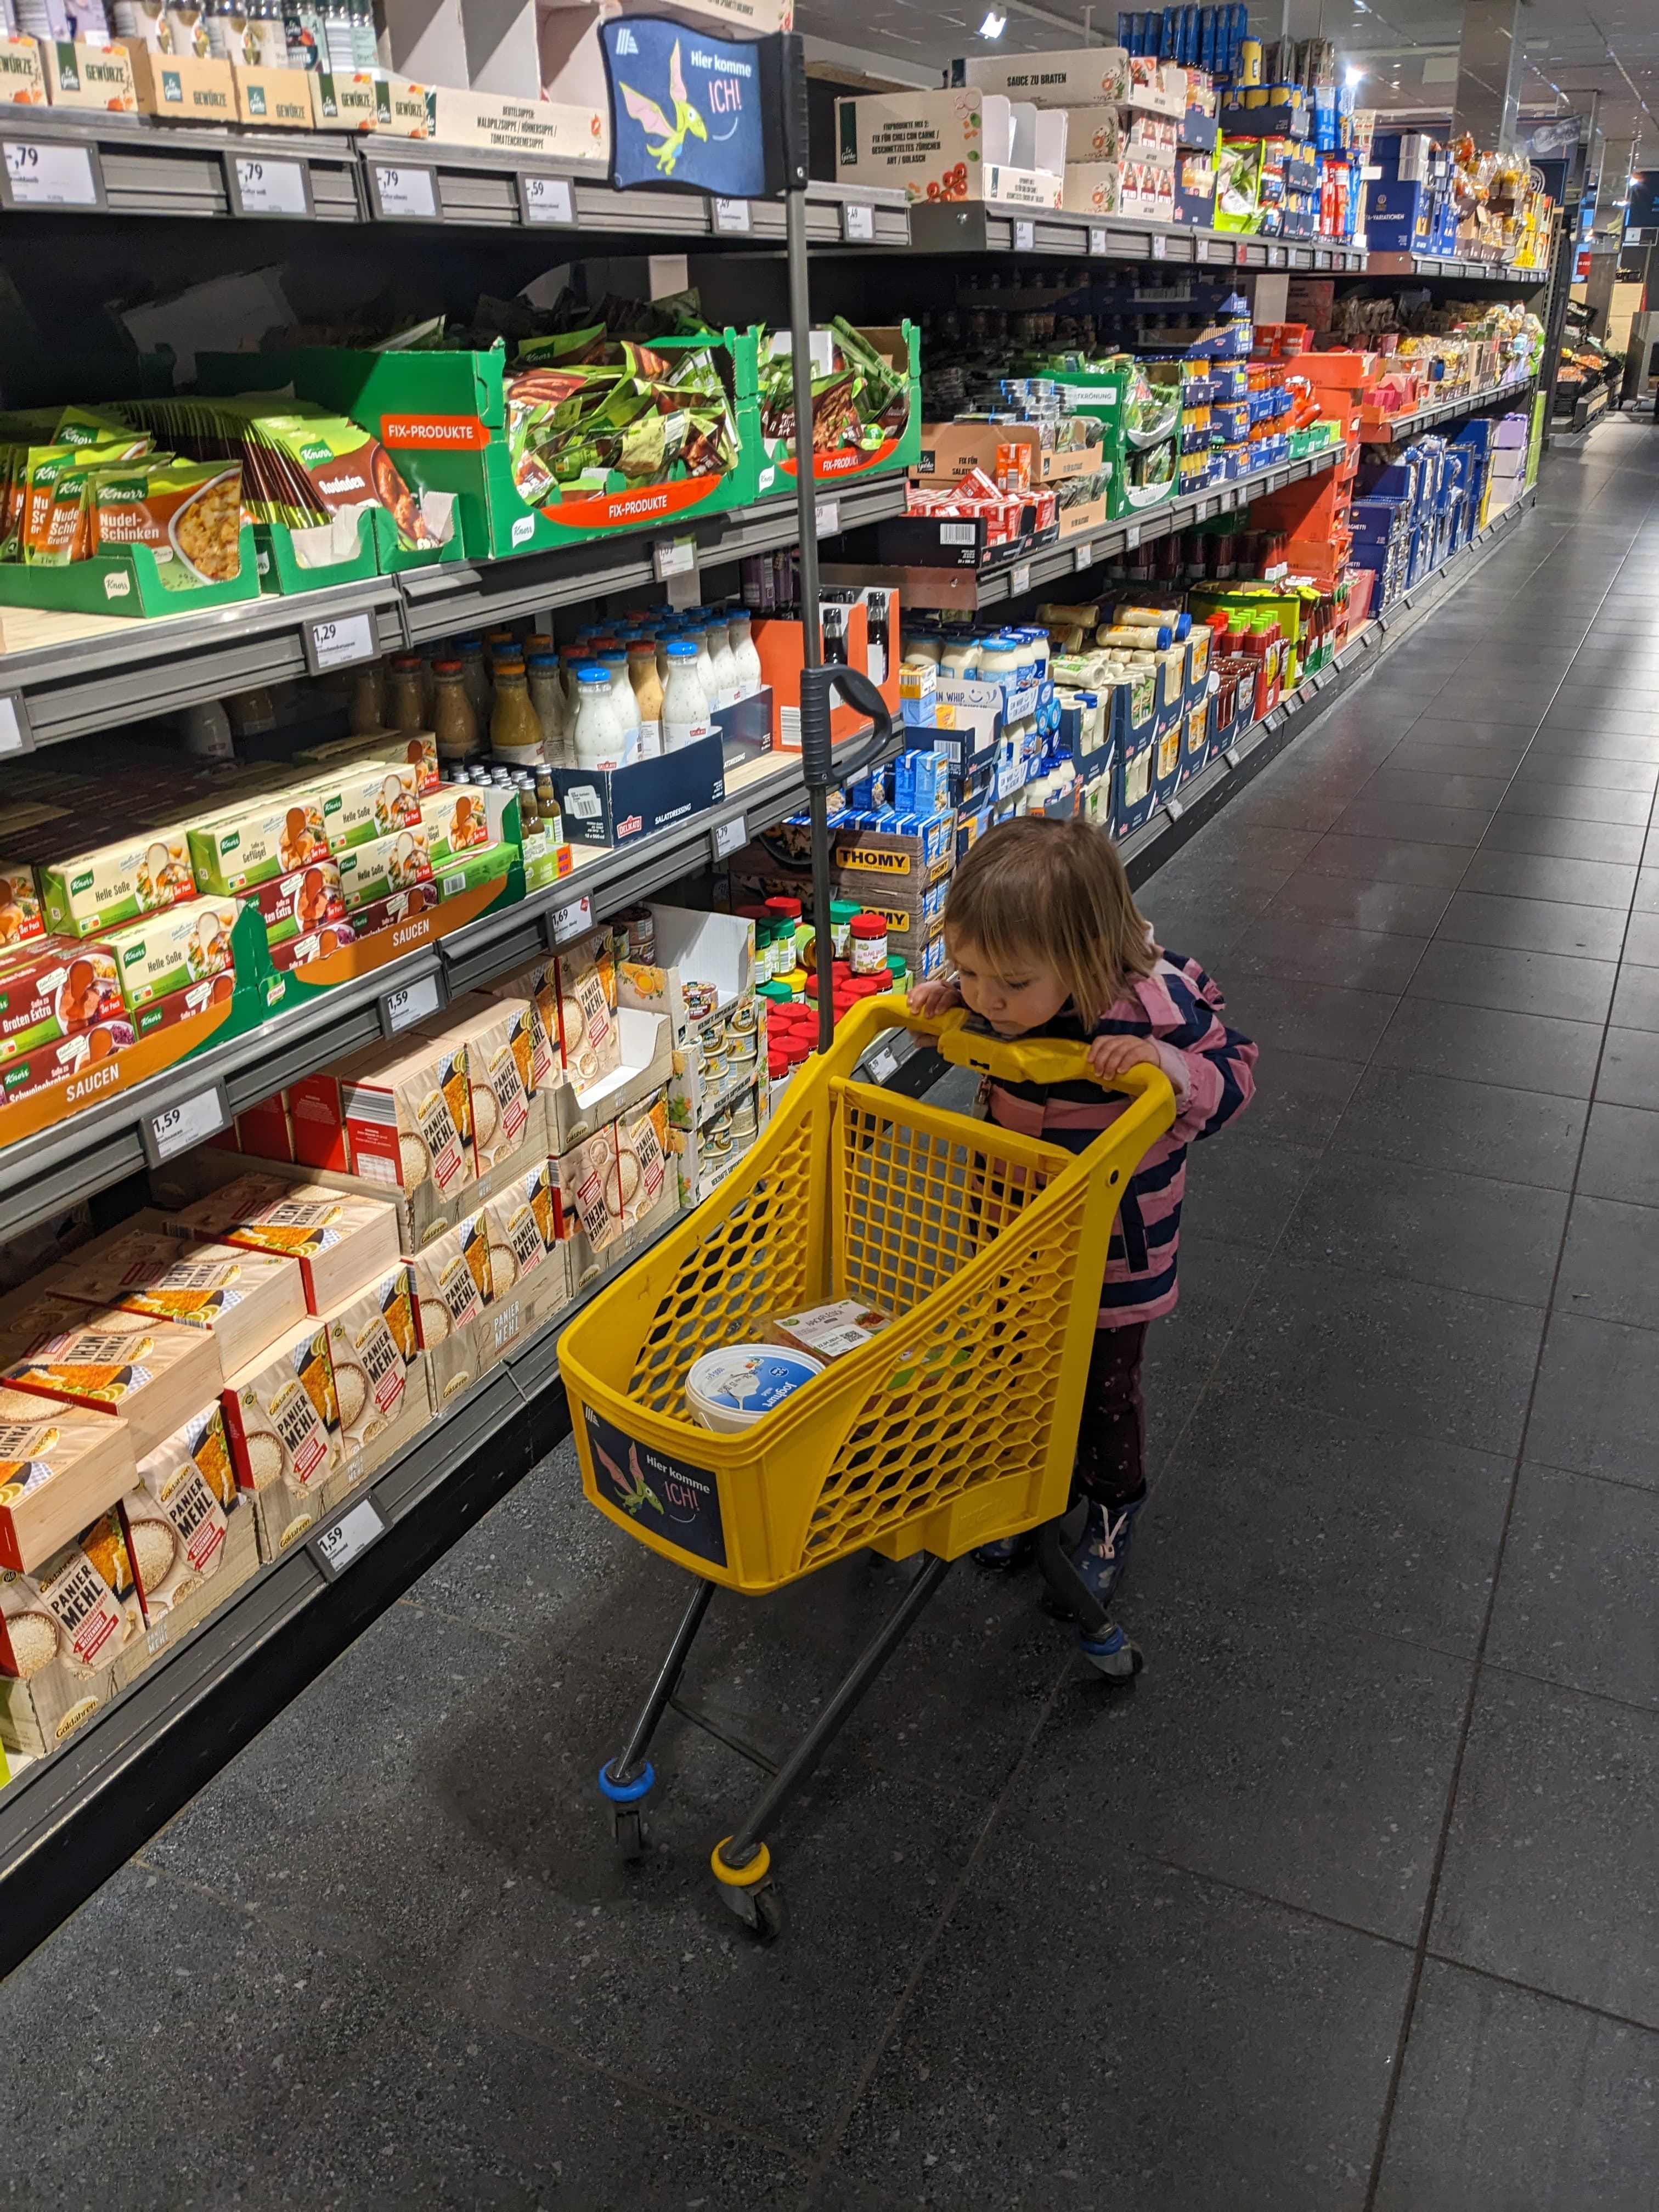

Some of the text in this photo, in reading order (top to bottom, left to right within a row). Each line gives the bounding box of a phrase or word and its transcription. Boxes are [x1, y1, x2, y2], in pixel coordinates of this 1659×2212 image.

[86, 63, 126, 82] GEWÜRZE
[691, 50, 752, 78] Hier komme
[1007, 72, 1066, 87] SAUCE ZU BRATEN
[193, 90, 227, 107] GEWÜRZE
[341, 91, 370, 107] GEWÜRZE
[708, 78, 743, 114] ICH!
[276, 103, 305, 119] GEWÜRZE
[396, 100, 422, 117] GEWÜRZE
[477, 116, 517, 132] WALDPILZSUPPE
[521, 121, 554, 136] HÜHNERSUPPE
[915, 121, 923, 129] MIX
[490, 133, 544, 150] TOMATENCREMESUPPE
[872, 134, 881, 143] FIX
[881, 132, 891, 143] FÜR
[892, 132, 906, 142] CHILI
[906, 132, 917, 140] CON
[918, 131, 935, 140] CARNE
[5, 146, 38, 167] -,79
[871, 144, 915, 155] GESCHNETZELTES
[887, 156, 898, 165] ART
[902, 154, 926, 163] GULASCH
[239, 163, 263, 181] -,79
[378, 171, 399, 189] -,79
[527, 181, 544, 196] -,59
[387, 424, 474, 440] FIX-PRODUKTE
[301, 445, 333, 461] Knorr
[967, 456, 978, 465] FÜR
[98, 486, 145, 500] Knorr
[318, 474, 366, 495] Rouladen
[608, 494, 668, 518] FIX-PRODUKTE
[100, 512, 142, 527] Nudel-
[100, 526, 160, 541] Schinken
[512, 525, 533, 537] Knorr
[106, 579, 129, 590] Knorr
[313, 624, 337, 644] 1,29
[324, 799, 343, 812] Knorr
[342, 806, 371, 823] Helle Soße
[655, 803, 691, 825] SALATDRESSING
[619, 820, 640, 836] DELIKATO
[715, 826, 729, 840] 1,79
[220, 836, 240, 850] Knorr
[242, 848, 267, 864] Geflügel
[340, 859, 357, 872] Knorr
[840, 850, 906, 868] THOMY
[357, 864, 384, 881] Helle Soße
[932, 861, 948, 878] THOMY
[71, 875, 95, 890] Knorr
[95, 882, 131, 902] Helle Soße
[275, 905, 292, 919] Extra
[552, 909, 568, 925] 1,69
[392, 918, 430, 947] SAUCEN
[124, 947, 146, 961] Knorr
[148, 951, 183, 973] Helle Soße
[388, 991, 408, 1011] 1,59
[580, 977, 600, 1004] PANIER
[31, 998, 43, 1009] Soße
[584, 989, 605, 1021] MEHL
[2, 1005, 52, 1033] Braten Extra
[140, 1011, 162, 1028] Knorr
[698, 1016, 714, 1031] HERZHAFTE
[714, 1000, 738, 1019] SUPPENEINLAGEN
[489, 1049, 509, 1071] Goldähren
[4, 1069, 30, 1085] Knorr
[50, 1067, 64, 1078] Soße
[66, 1063, 119, 1102] SAUCEN
[494, 1060, 515, 1092] PANIER
[498, 1076, 521, 1109] MEHL
[714, 1076, 751, 1109] HERZHAFTE SUPPENEINLAGEN
[418, 1094, 439, 1120] Goldähren
[153, 1109, 180, 1133] 1,59
[424, 1106, 449, 1137] PANIER
[429, 1124, 455, 1157] MEHL
[566, 1126, 588, 1143] Goldähren
[635, 1126, 655, 1155] PANIER
[639, 1141, 660, 1170] MEHL
[711, 1170, 729, 1187] HERZHAFTE
[268, 1204, 298, 1223] MEHL
[293, 1205, 322, 1224] PANIER
[507, 1207, 528, 1233] Goldähren
[584, 1196, 607, 1223] MEHL
[421, 1221, 447, 1244] Goldähren
[512, 1216, 535, 1250] PANIER
[589, 1214, 609, 1242] PANIER
[517, 1230, 541, 1266] MEHL
[159, 1264, 193, 1288] MEHL
[186, 1264, 217, 1288] PANIER
[439, 1257, 461, 1287] Goldähren
[444, 1269, 470, 1302] PANIER
[449, 1282, 476, 1320] MEHL
[494, 1300, 520, 1328] PANIER
[356, 1319, 380, 1349] Goldähren
[495, 1318, 520, 1349] MEHL
[64, 1335, 108, 1363] MEHL
[93, 1335, 128, 1362] PANIER
[362, 1331, 390, 1369] PANIER
[368, 1346, 397, 1384] MEHL
[443, 1376, 467, 1399] Goldähren
[762, 1381, 797, 1407] Joghurt
[269, 1382, 296, 1416] Goldähren
[276, 1395, 308, 1436] PANIER
[284, 1410, 317, 1453] MEHL
[161, 1465, 191, 1503] Goldähren
[646, 1454, 710, 1494] Hier komme
[168, 1478, 204, 1521] PANIER
[665, 1481, 699, 1512] ICH!
[177, 1493, 213, 1541] MEHL
[192, 1528, 214, 1558] WEIZENBROT
[280, 1517, 310, 1549] Goldähren
[318, 1527, 343, 1551] 1,59
[40, 1552, 76, 1594] Goldähren
[50, 1564, 92, 1615] PANIER
[61, 1580, 104, 1632] MEHL
[80, 1617, 105, 1649] WEIZENBROT
[148, 1634, 169, 1655] MEHL
[56, 1699, 97, 1739] Goldähren
